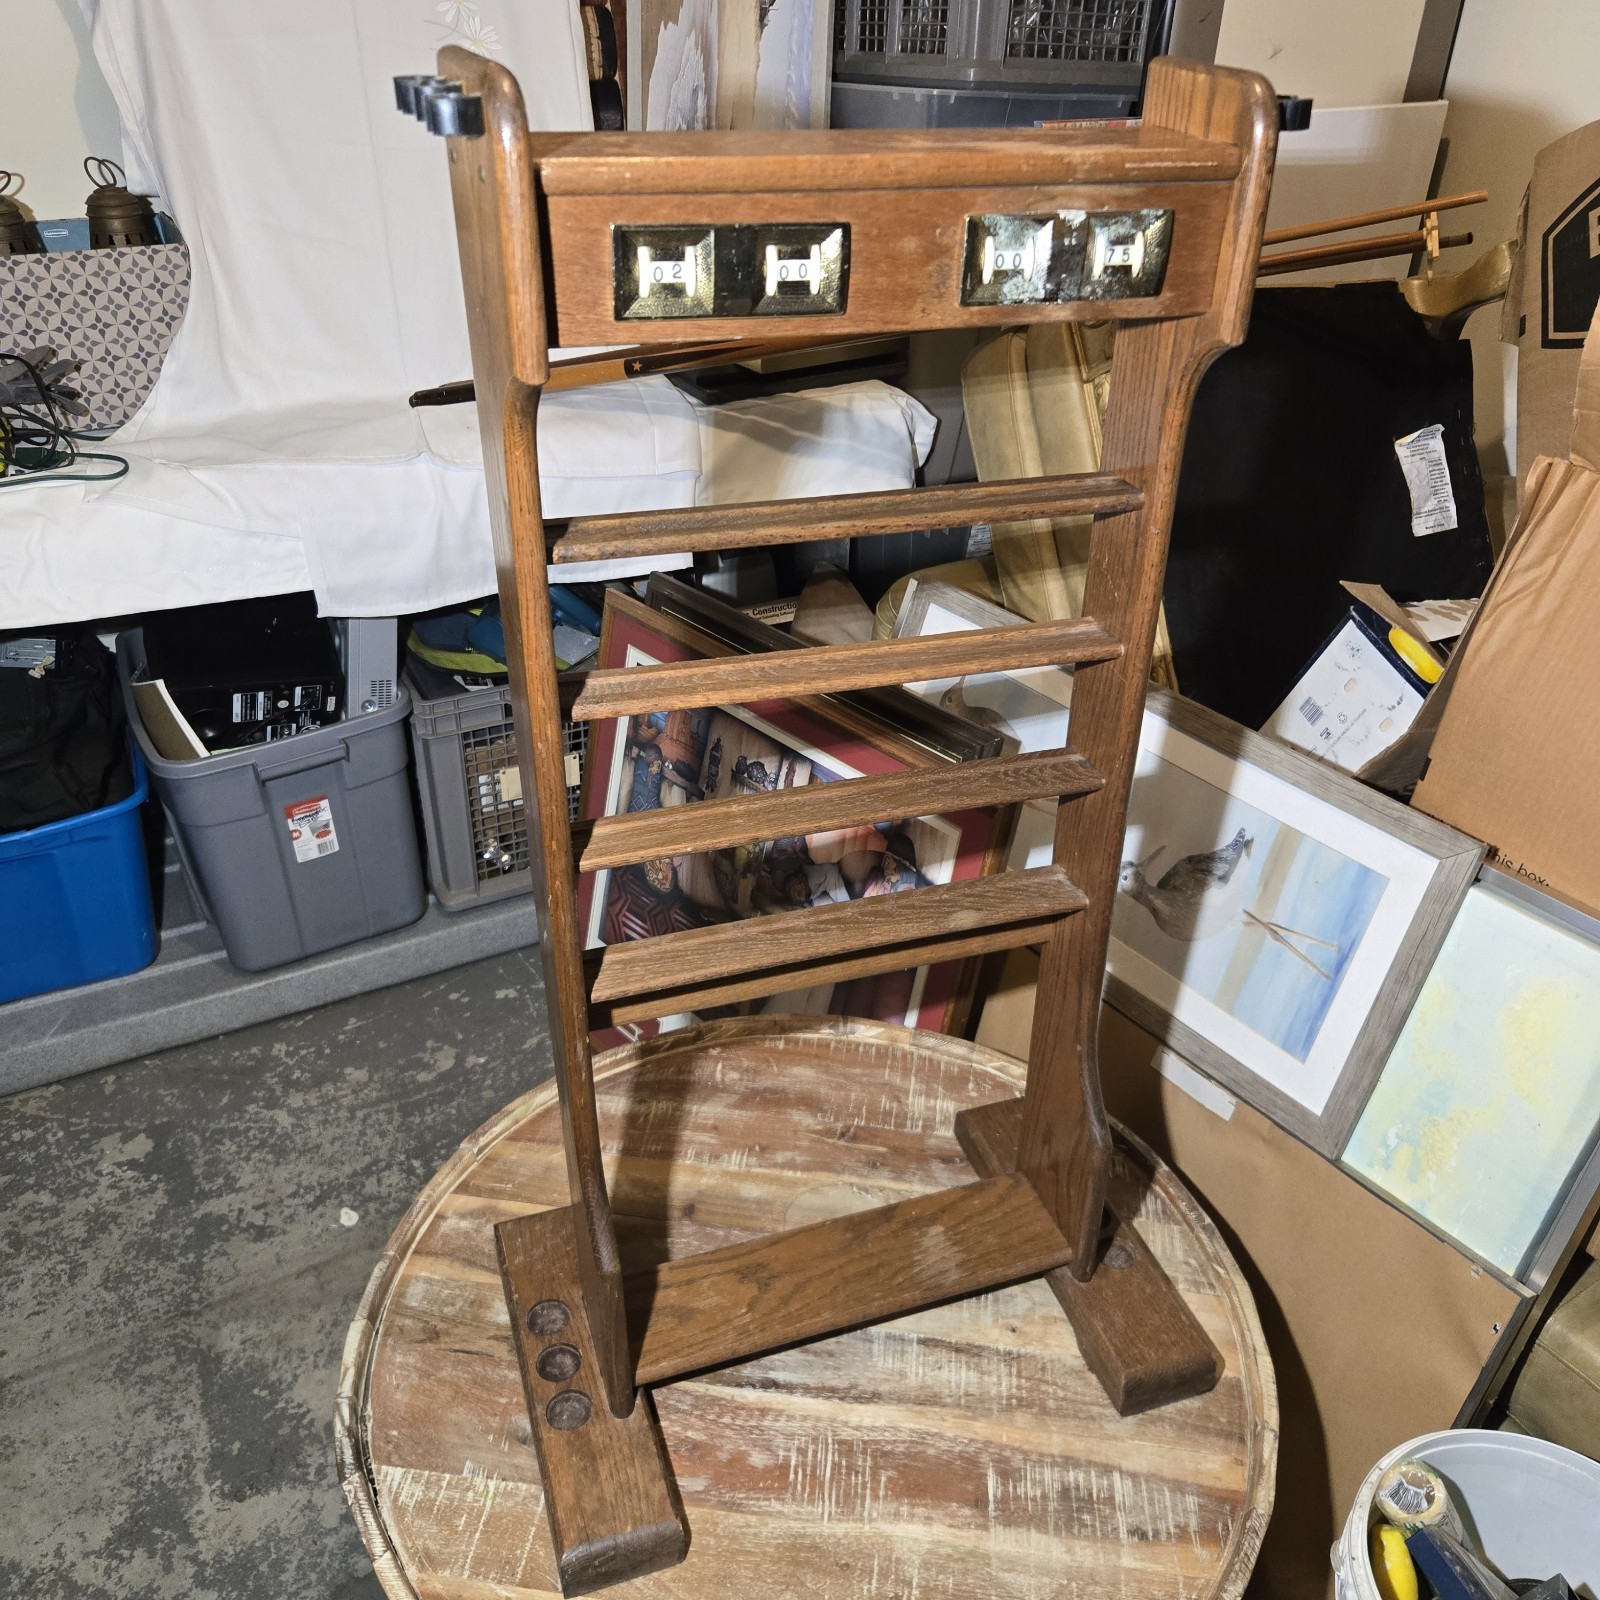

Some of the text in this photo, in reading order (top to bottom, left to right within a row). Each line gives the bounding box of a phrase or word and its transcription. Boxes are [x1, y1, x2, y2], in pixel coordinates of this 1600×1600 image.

[995, 247, 1130, 270] 00 75
[653, 263, 808, 282] 02 00
[752, 601, 798, 616] Constructio
